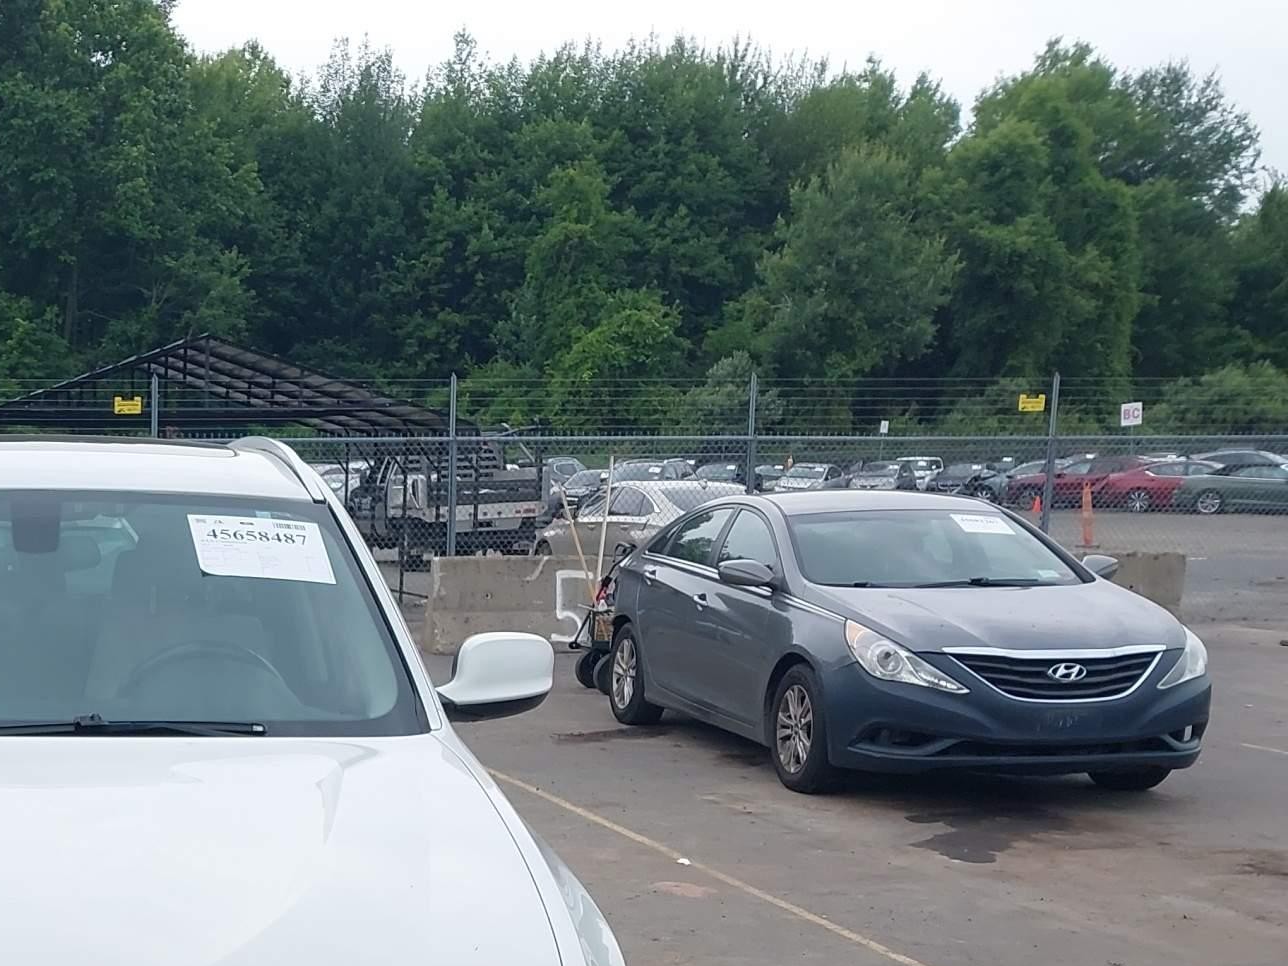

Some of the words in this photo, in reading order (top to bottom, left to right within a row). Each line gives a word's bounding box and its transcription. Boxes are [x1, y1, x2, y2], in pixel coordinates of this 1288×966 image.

[1123, 408, 1140, 421] BC
[206, 528, 307, 546] 45658487
[551, 570, 593, 641] 5
